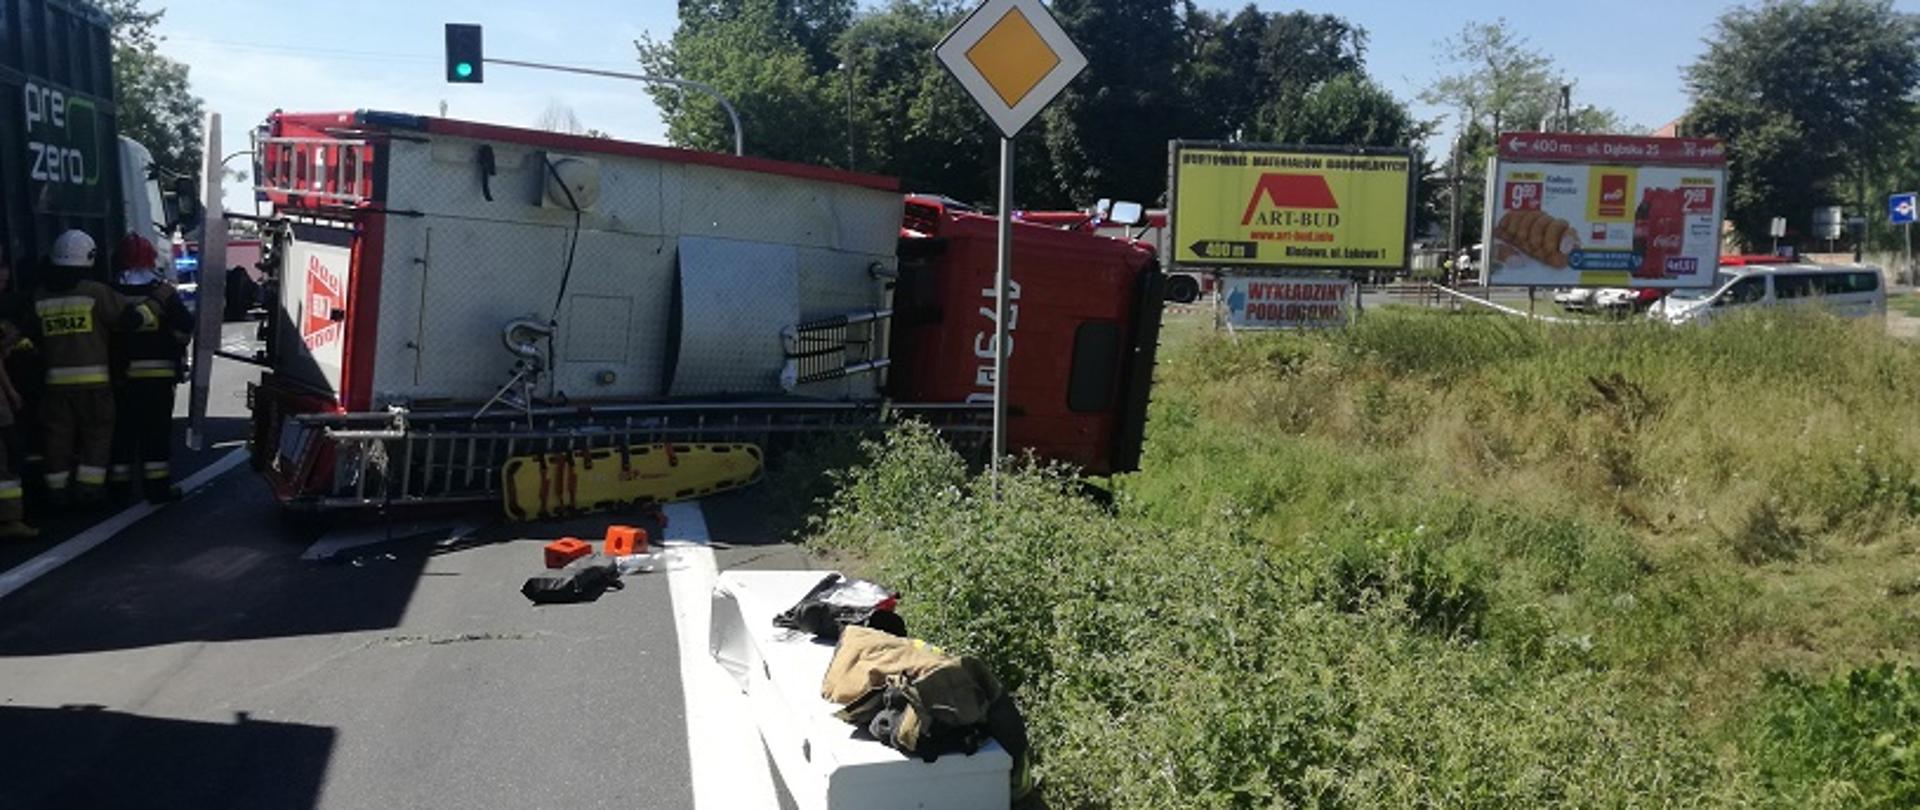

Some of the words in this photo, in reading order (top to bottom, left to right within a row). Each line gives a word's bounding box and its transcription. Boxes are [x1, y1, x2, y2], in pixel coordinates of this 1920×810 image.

[24, 82, 65, 131] pre
[1533, 139, 1558, 152] 400
[28, 141, 84, 185] zero
[1256, 210, 1339, 228] ART-BUD
